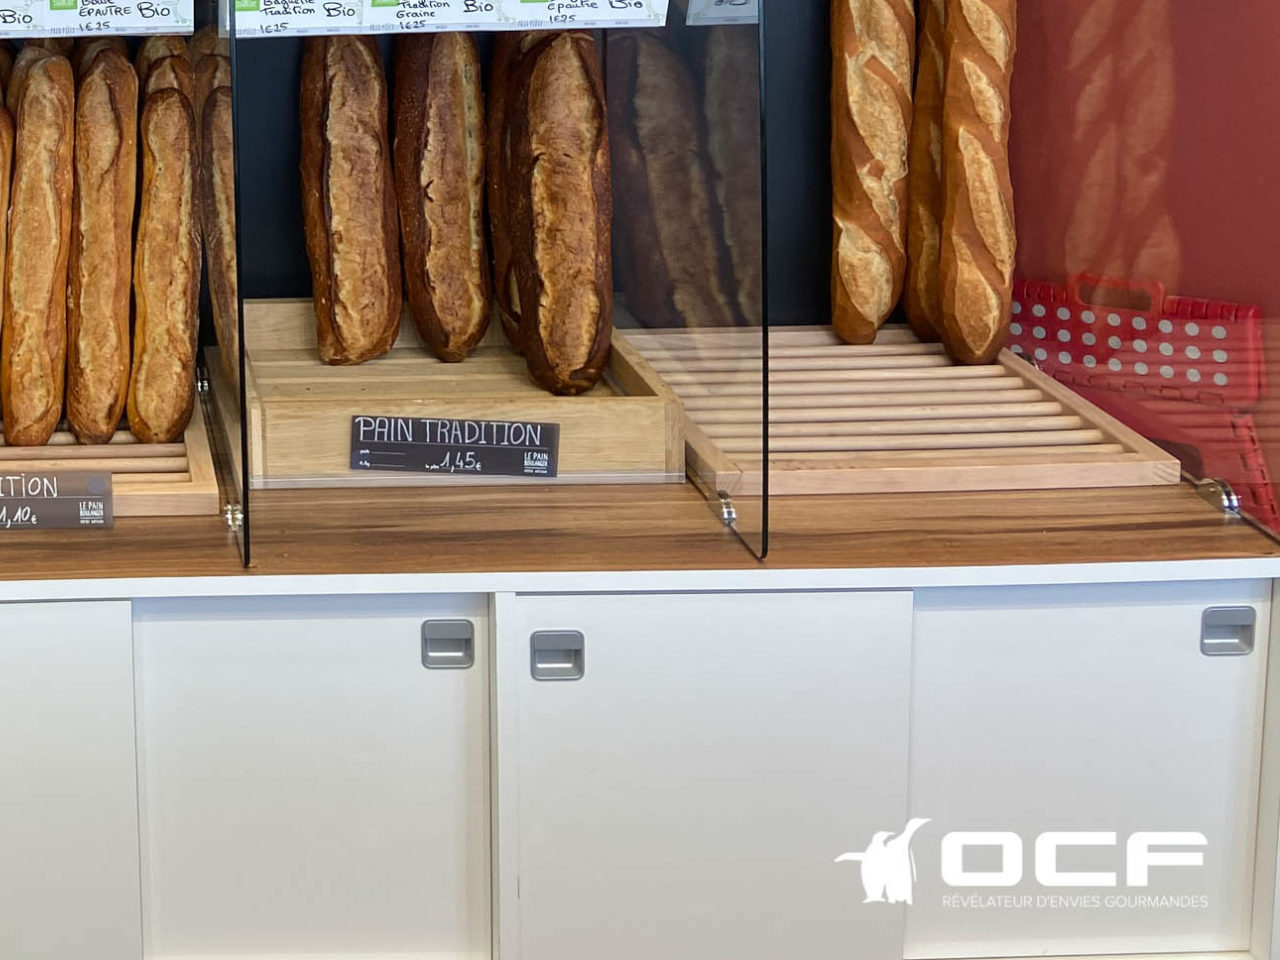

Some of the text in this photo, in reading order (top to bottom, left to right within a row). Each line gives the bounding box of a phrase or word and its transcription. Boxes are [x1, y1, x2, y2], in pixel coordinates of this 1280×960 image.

[137, 1, 171, 18] Bio
[323, 2, 356, 17] Bio
[396, 10, 436, 18] Graine
[463, 0, 494, 13] Bio
[355, 417, 541, 446] PAIN TRADITION
